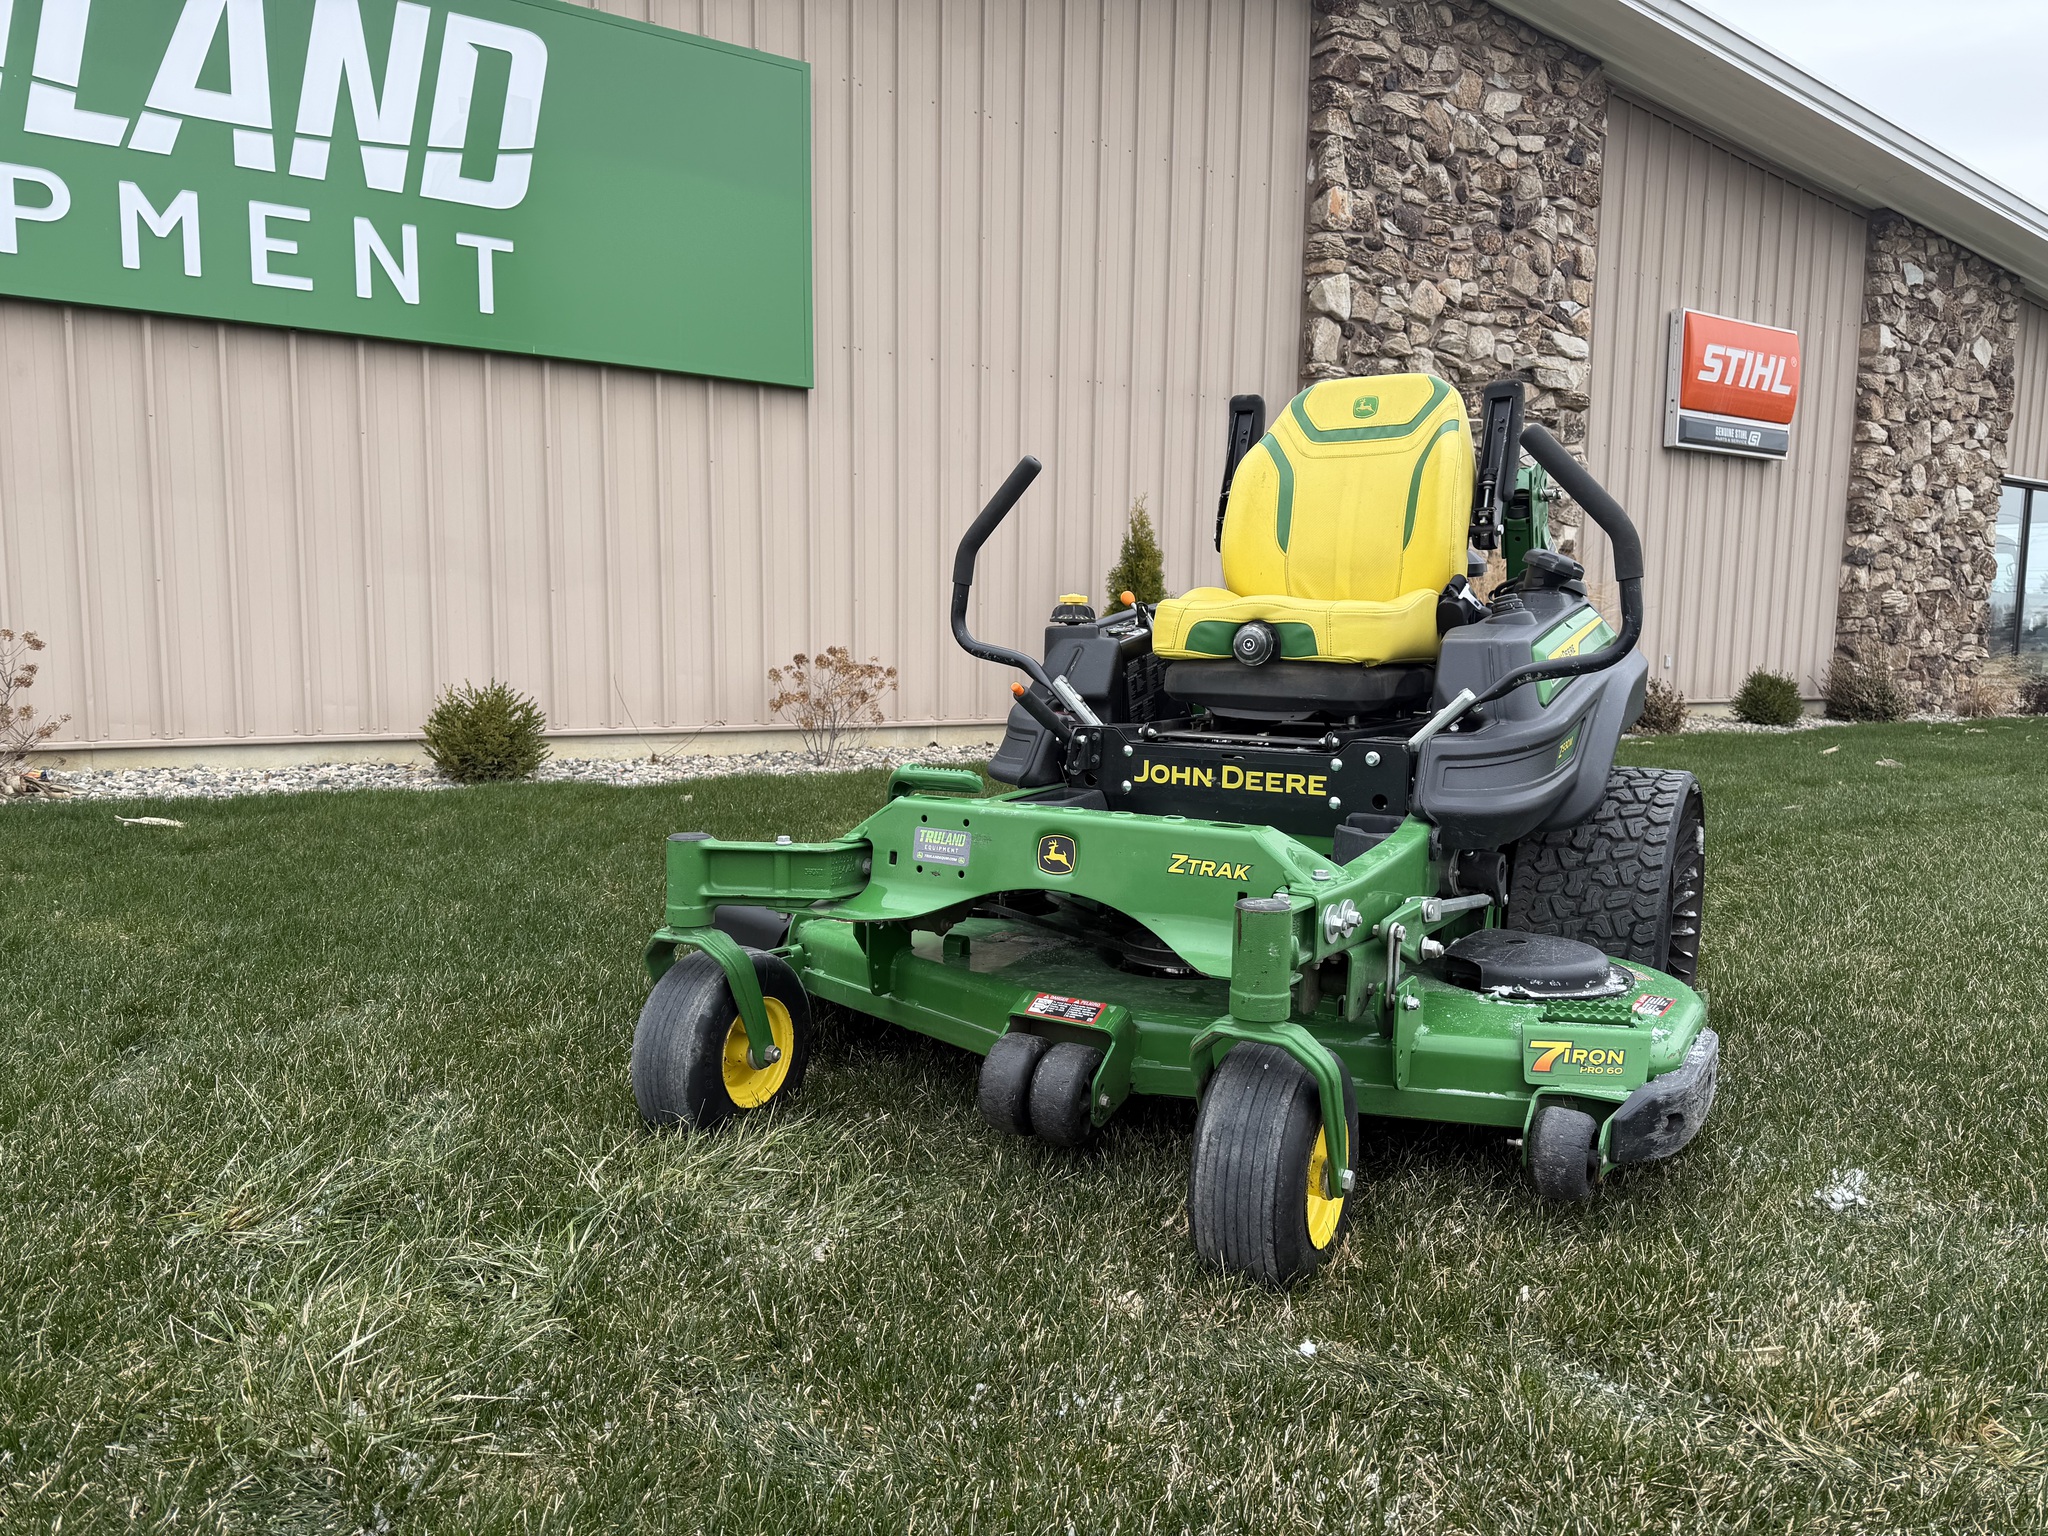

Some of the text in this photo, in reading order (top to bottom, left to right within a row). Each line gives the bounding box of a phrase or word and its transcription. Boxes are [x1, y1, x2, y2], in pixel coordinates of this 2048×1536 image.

[0, 0, 548, 210] LAND
[1697, 343, 1793, 395] STIHL
[1133, 759, 1328, 797] JOHN DEERE
[919, 829, 967, 847] TRULAND
[924, 844, 959, 853] EQUIPMENT
[1167, 853, 1252, 882] ZTRAK
[1049, 995, 1070, 1003] DANGER
[1080, 999, 1101, 1008] PELIGRO
[1579, 1065, 1624, 1076] PRO 60
